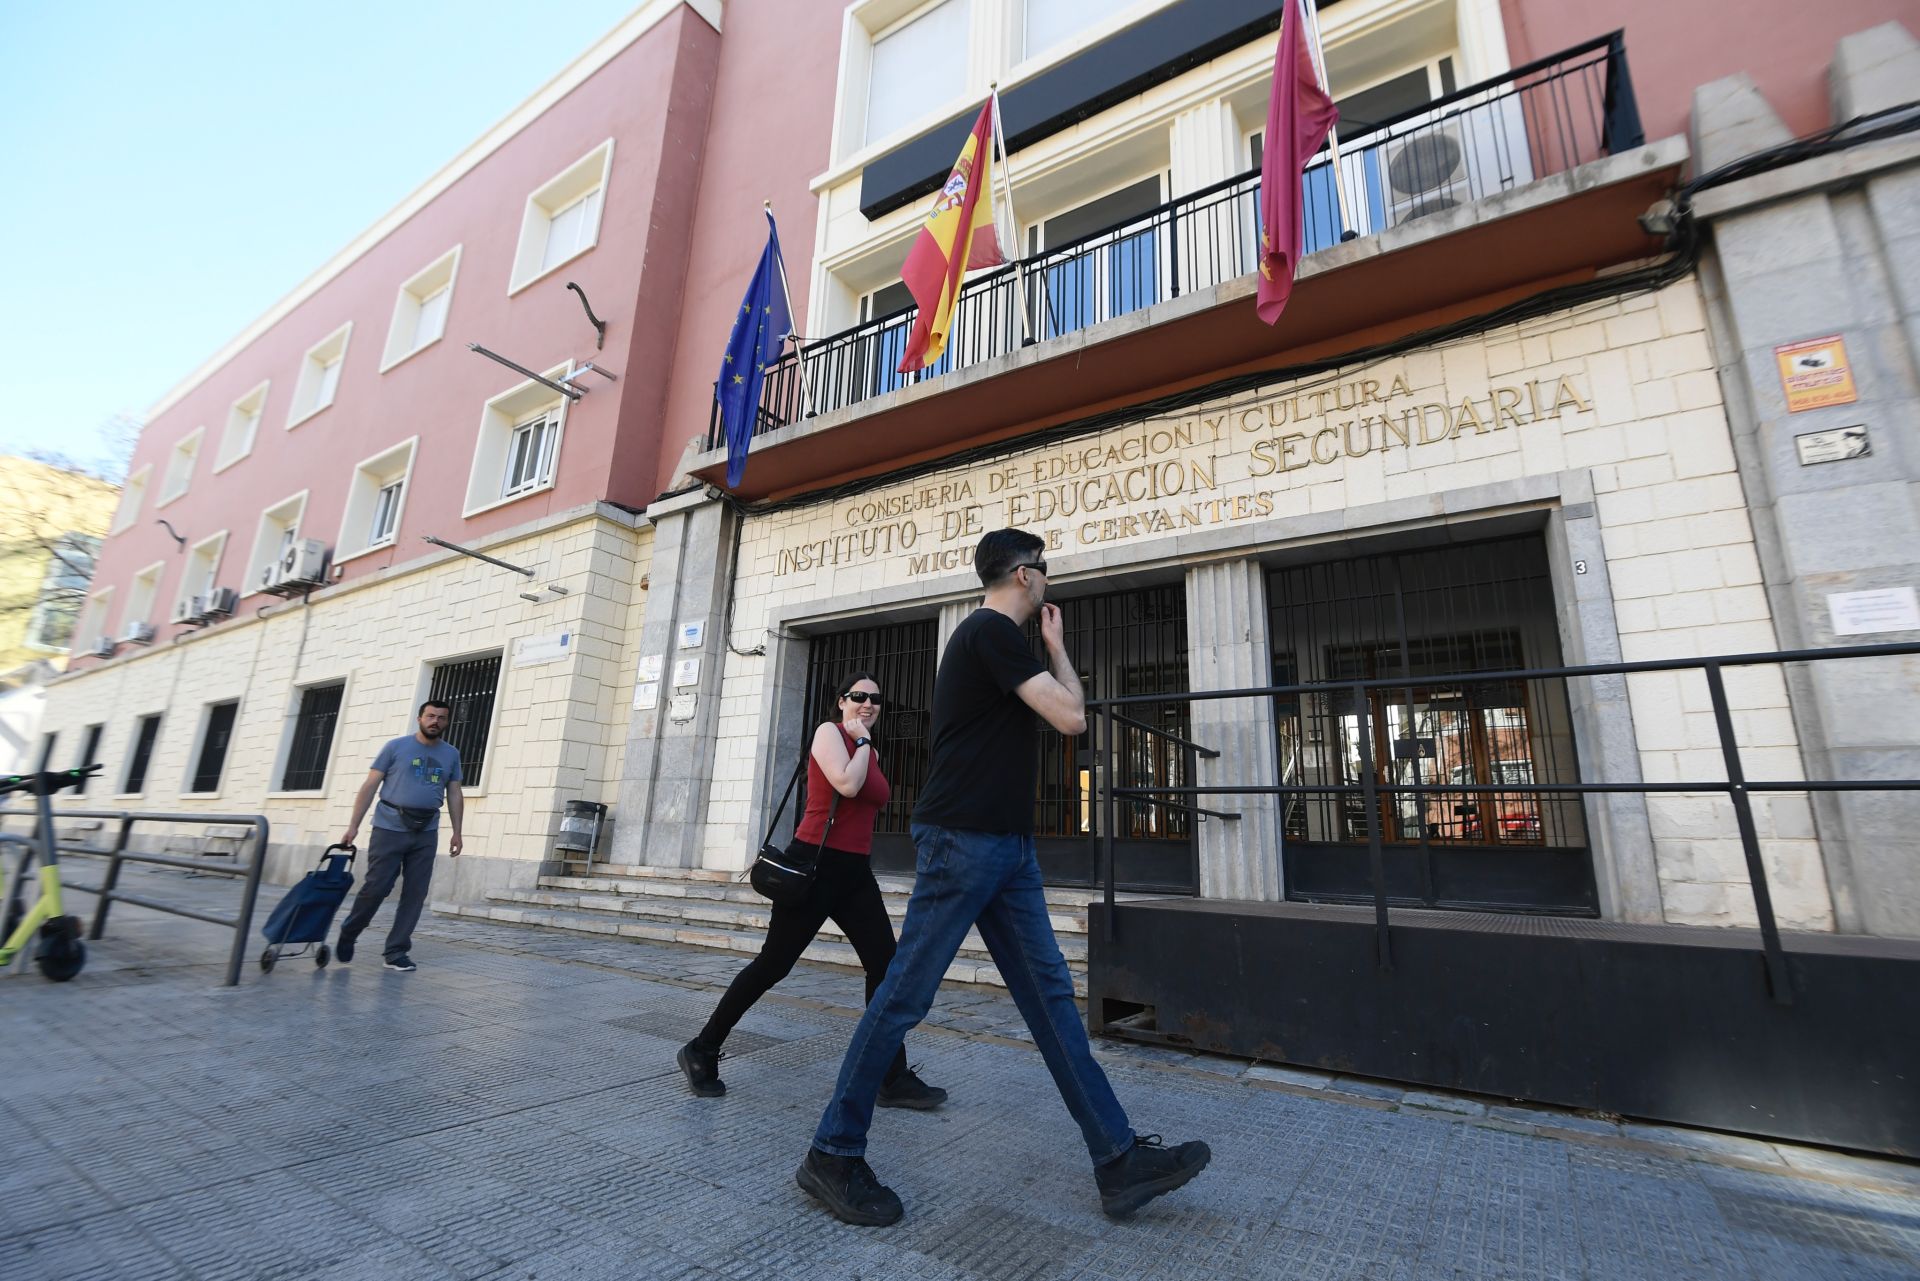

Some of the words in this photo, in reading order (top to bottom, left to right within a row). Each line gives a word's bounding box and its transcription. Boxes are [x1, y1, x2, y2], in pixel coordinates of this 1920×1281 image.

[774, 520, 917, 577] INSTITUTO
[940, 504, 985, 542] DE
[1005, 455, 1217, 529] EDUCACION
[1248, 373, 1593, 477] SECUNDARIA
[846, 479, 974, 526] CONSEJERIA
[988, 467, 1018, 494] DE
[1032, 421, 1194, 483] EDUCACION
[1204, 415, 1225, 442] Y
[1239, 373, 1414, 433] CULTURA
[907, 545, 977, 577] MIGU
[1076, 490, 1274, 545] CERVANTES
[1576, 560, 1587, 575] 3
